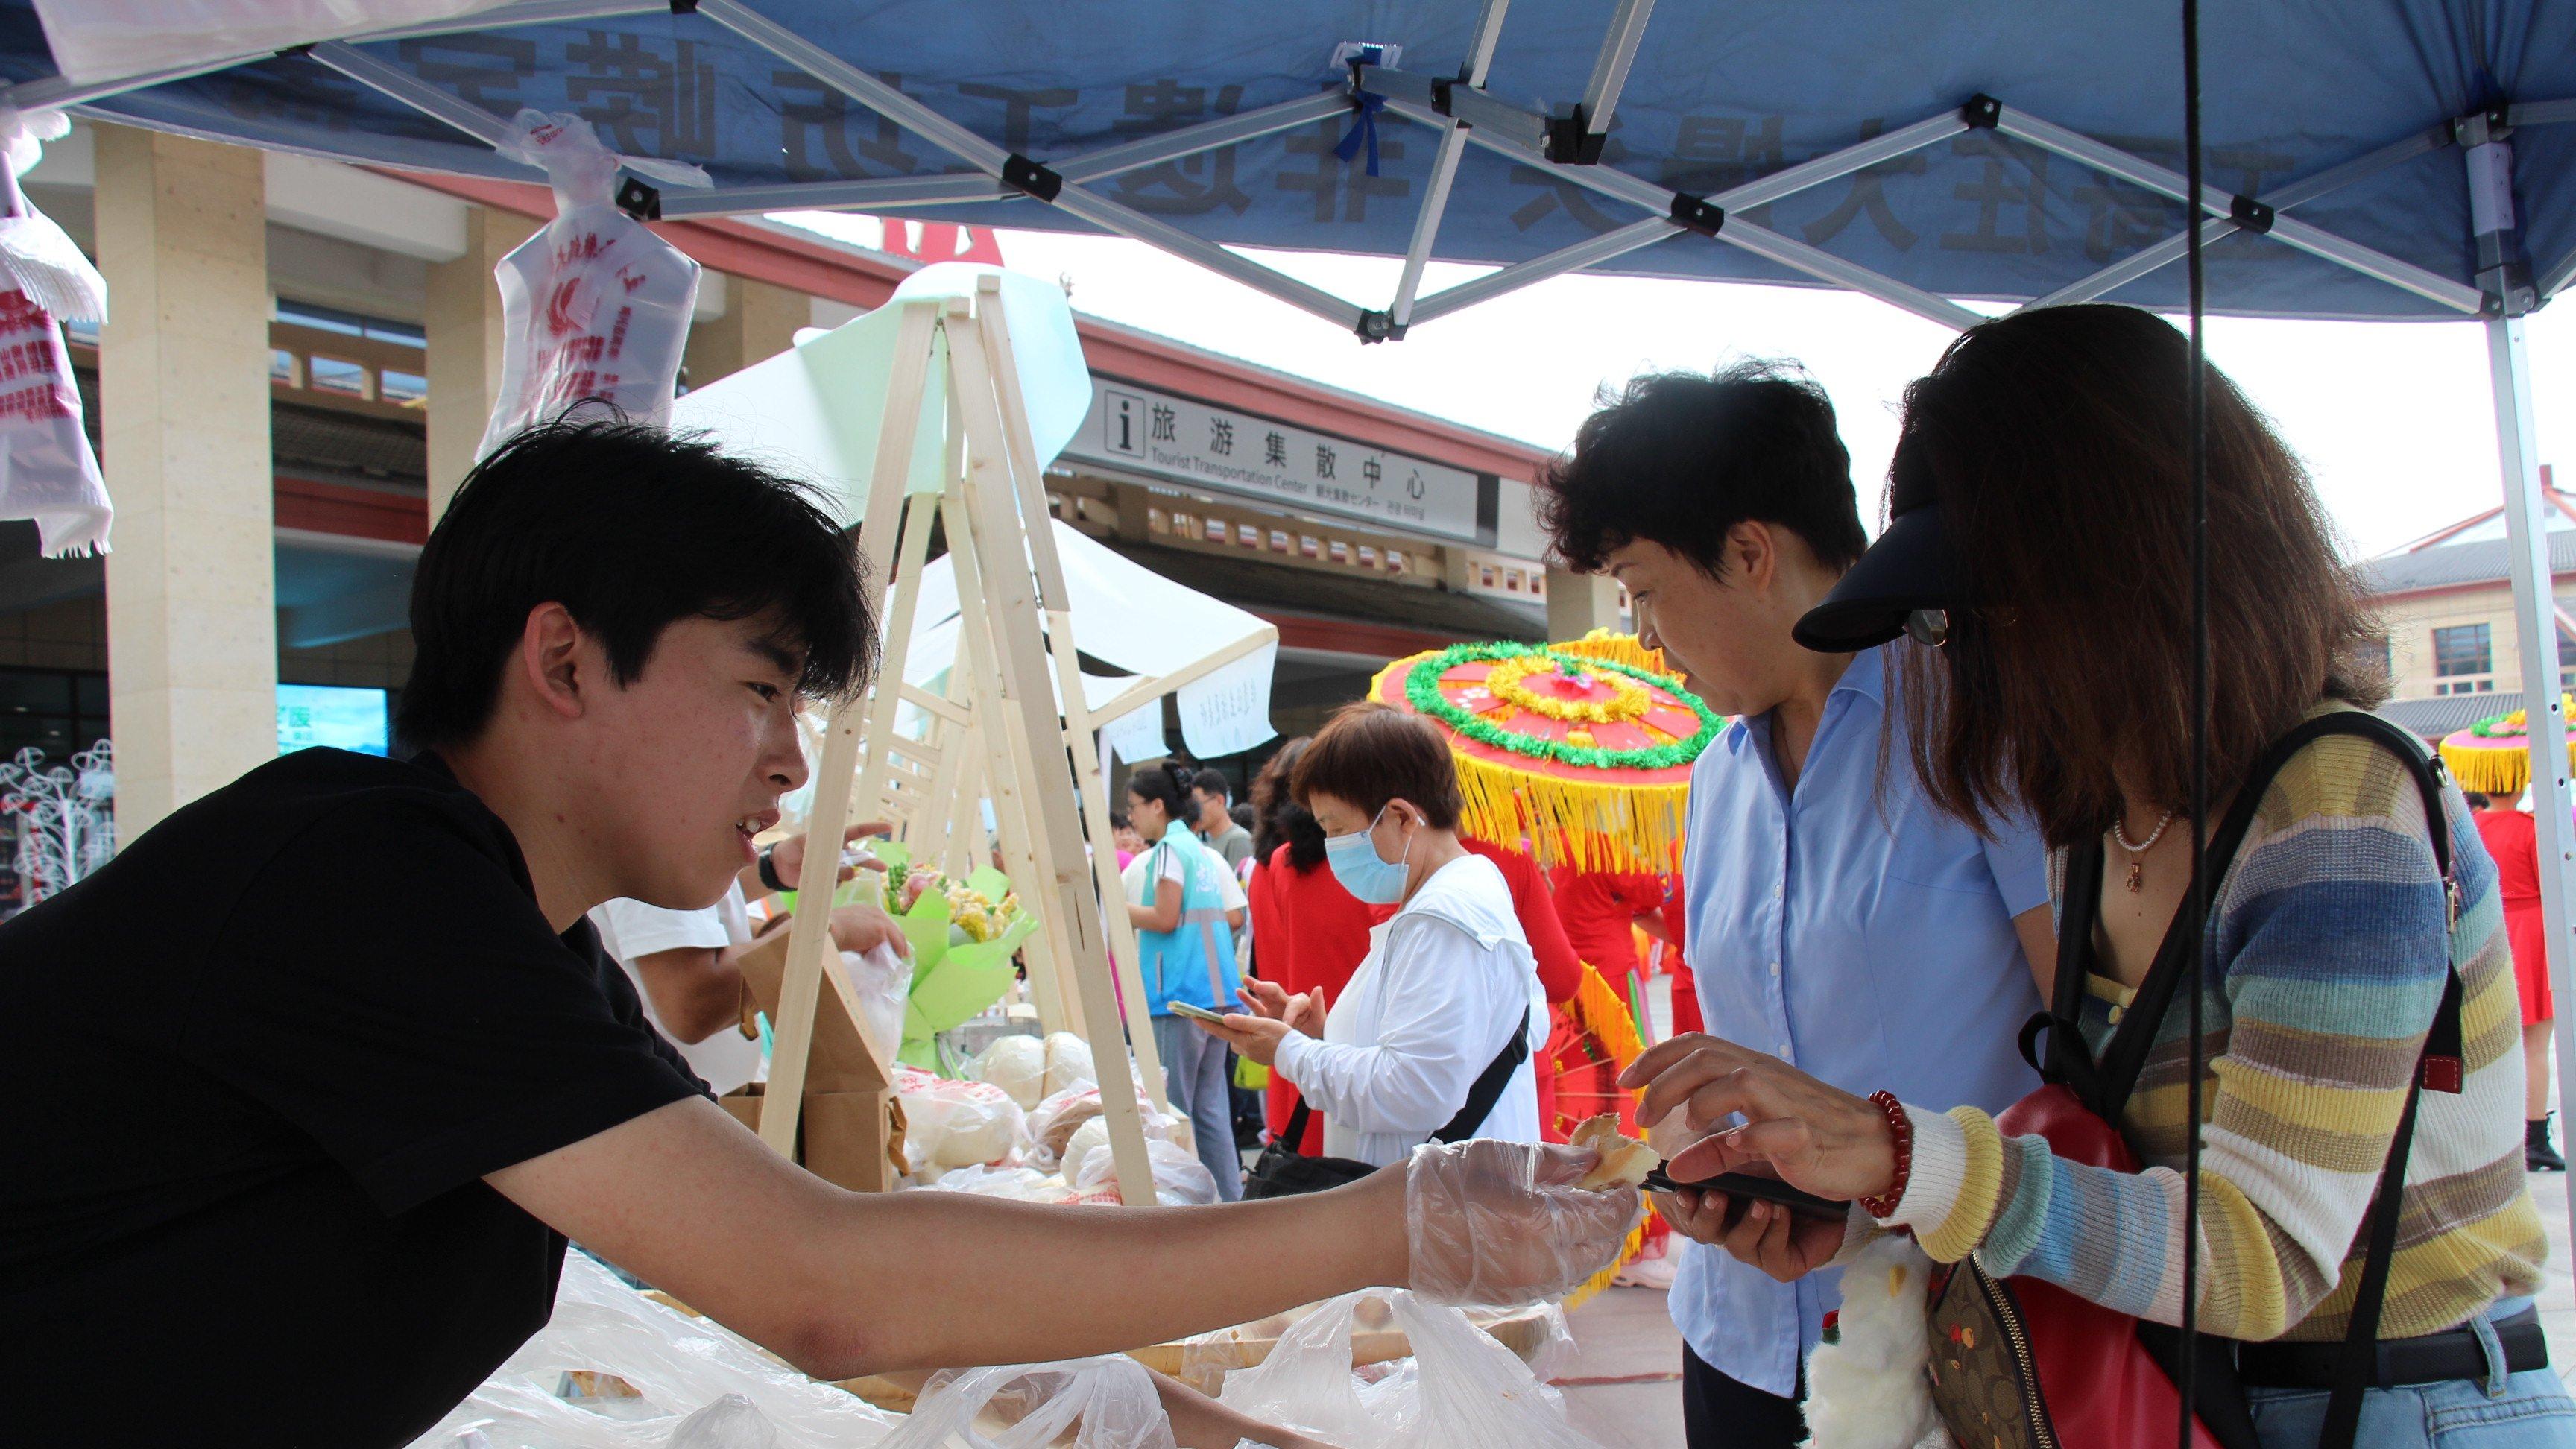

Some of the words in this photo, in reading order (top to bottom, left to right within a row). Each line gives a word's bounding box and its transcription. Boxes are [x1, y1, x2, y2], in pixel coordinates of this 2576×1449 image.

[1151, 402, 1426, 500] 旅游集散中心
[1152, 446, 1190, 469] Tourist
[1193, 456, 1272, 484] Transportation
[1275, 474, 1307, 493] Center
